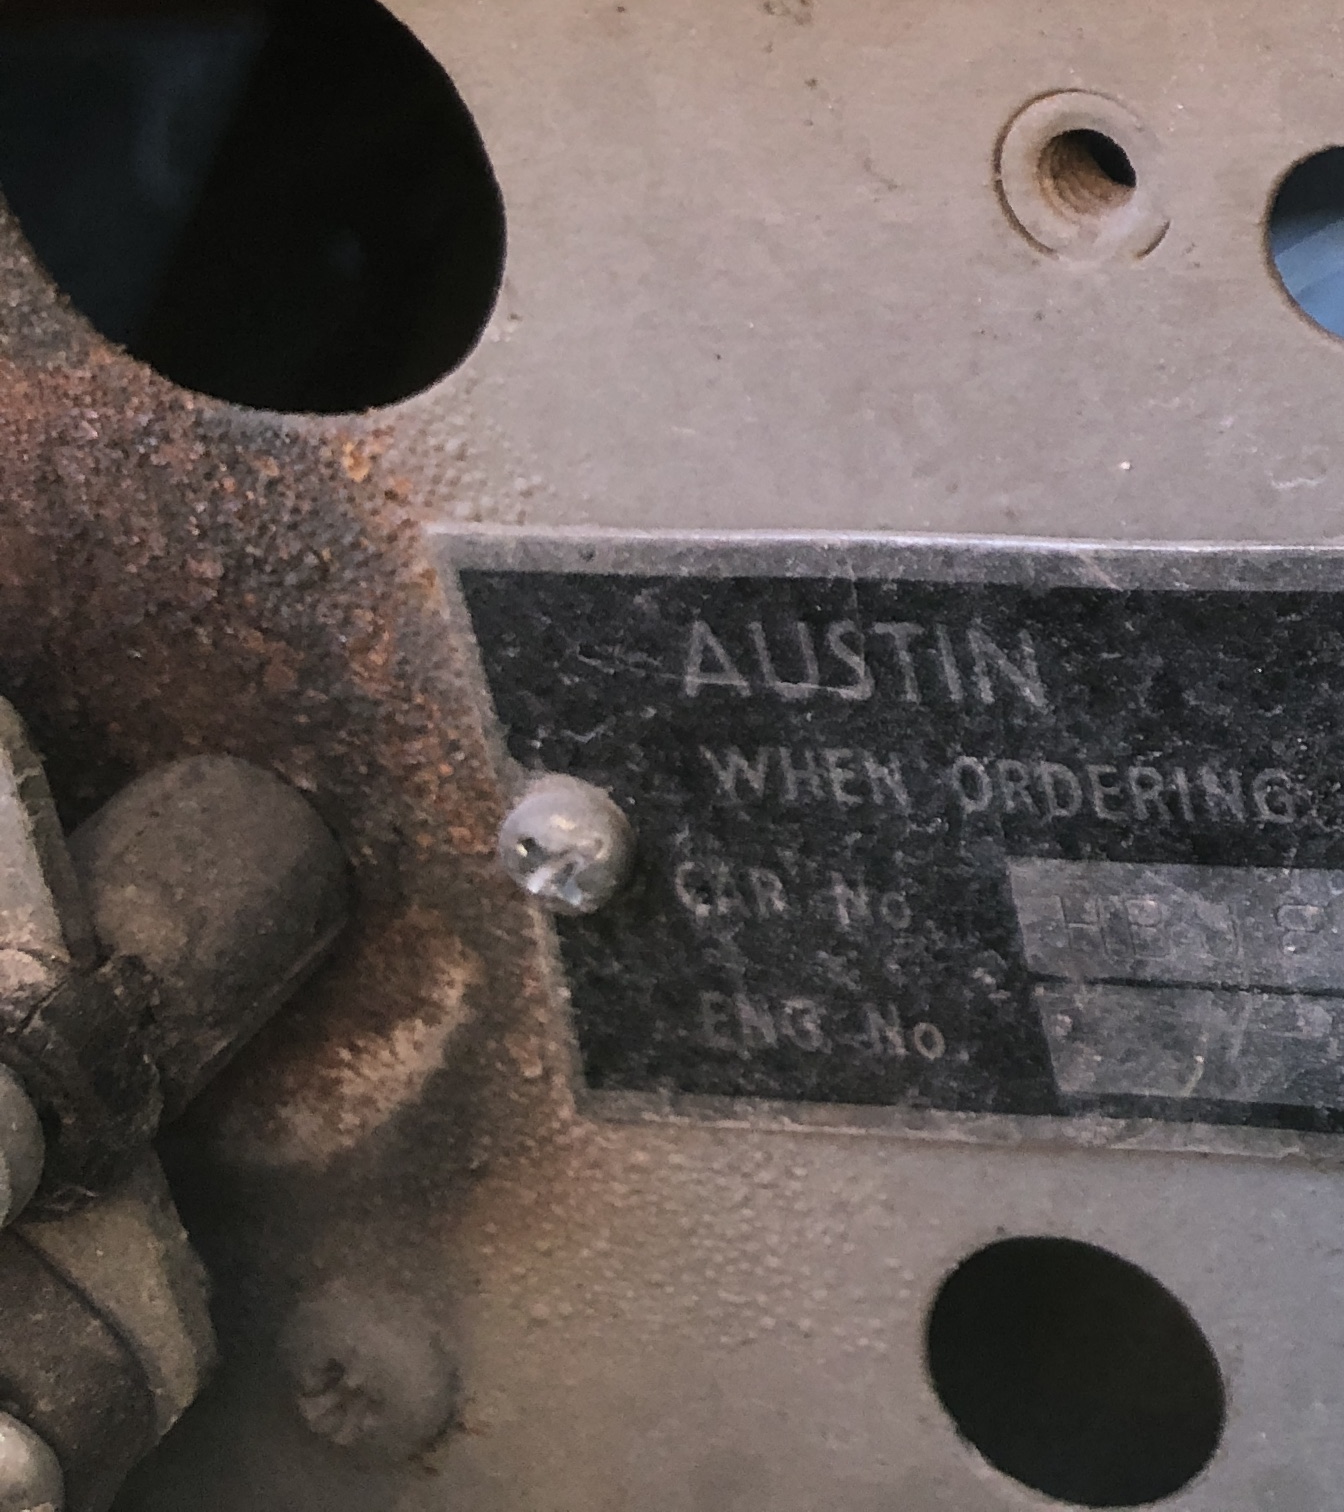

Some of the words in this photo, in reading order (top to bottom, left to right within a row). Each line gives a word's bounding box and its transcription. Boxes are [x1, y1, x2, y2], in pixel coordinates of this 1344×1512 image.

[683, 618, 1049, 711] AUSTIN
[704, 744, 912, 810] WHEN
[955, 753, 1297, 826] ORDERING
